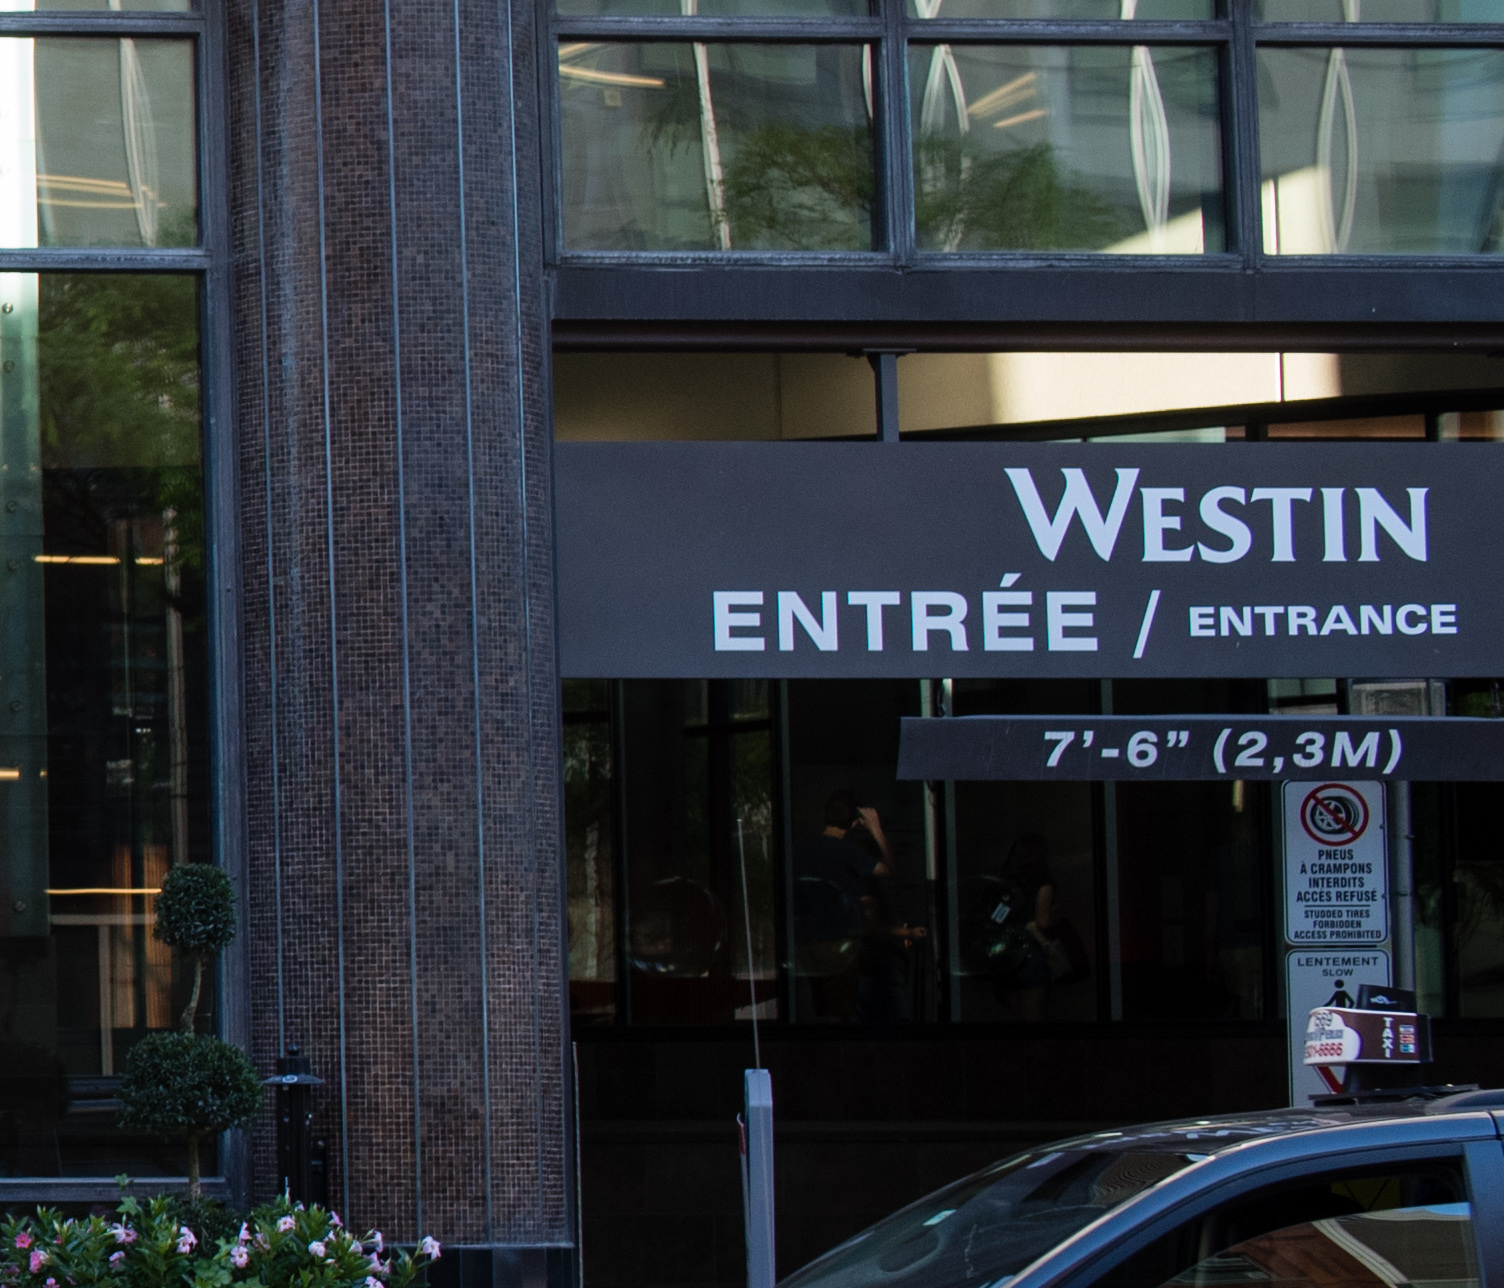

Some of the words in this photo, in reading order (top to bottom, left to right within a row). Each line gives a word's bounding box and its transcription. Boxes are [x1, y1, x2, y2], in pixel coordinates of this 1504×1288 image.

[1003, 466, 1430, 564] WESTIN
[713, 572, 1098, 652] ENTRÉE
[1133, 589, 1161, 659] /
[1189, 603, 1458, 638] ENTRANCE
[1213, 728, 1403, 775] (2,3M)
[1318, 850, 1354, 861] PNEUS
[1310, 863, 1373, 875] CRAMPONS
[1308, 877, 1365, 888] INTERDITS
[1335, 888, 1378, 902] REFUSÉ
[1304, 909, 1343, 919] STUDDED
[1346, 909, 1371, 919] TIRES
[1313, 919, 1362, 929] FORBIDDEN
[1293, 930, 1327, 940] ACCESS
[1329, 930, 1382, 940] PROHIBITED
[1297, 956, 1379, 967] LENTEMENT
[1322, 968, 1354, 977] SLOW
[1382, 1017, 1394, 1059] TAXI
